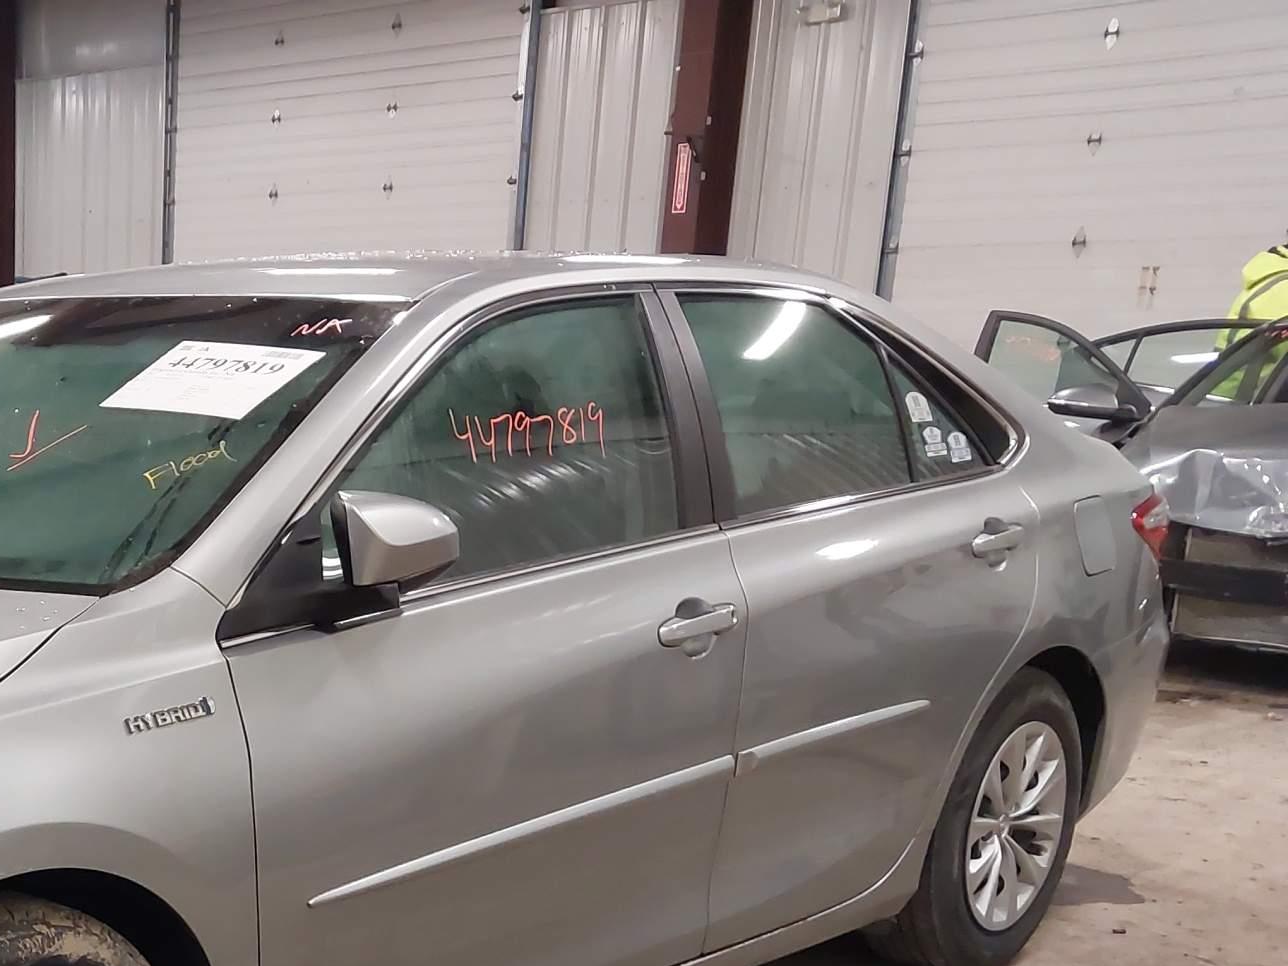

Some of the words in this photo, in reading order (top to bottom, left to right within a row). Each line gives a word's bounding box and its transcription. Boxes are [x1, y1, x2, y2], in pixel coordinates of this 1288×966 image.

[168, 356, 285, 375] 44797819
[448, 401, 607, 464] 44797819
[143, 440, 238, 490] Flood
[123, 701, 208, 734] HYBRID
